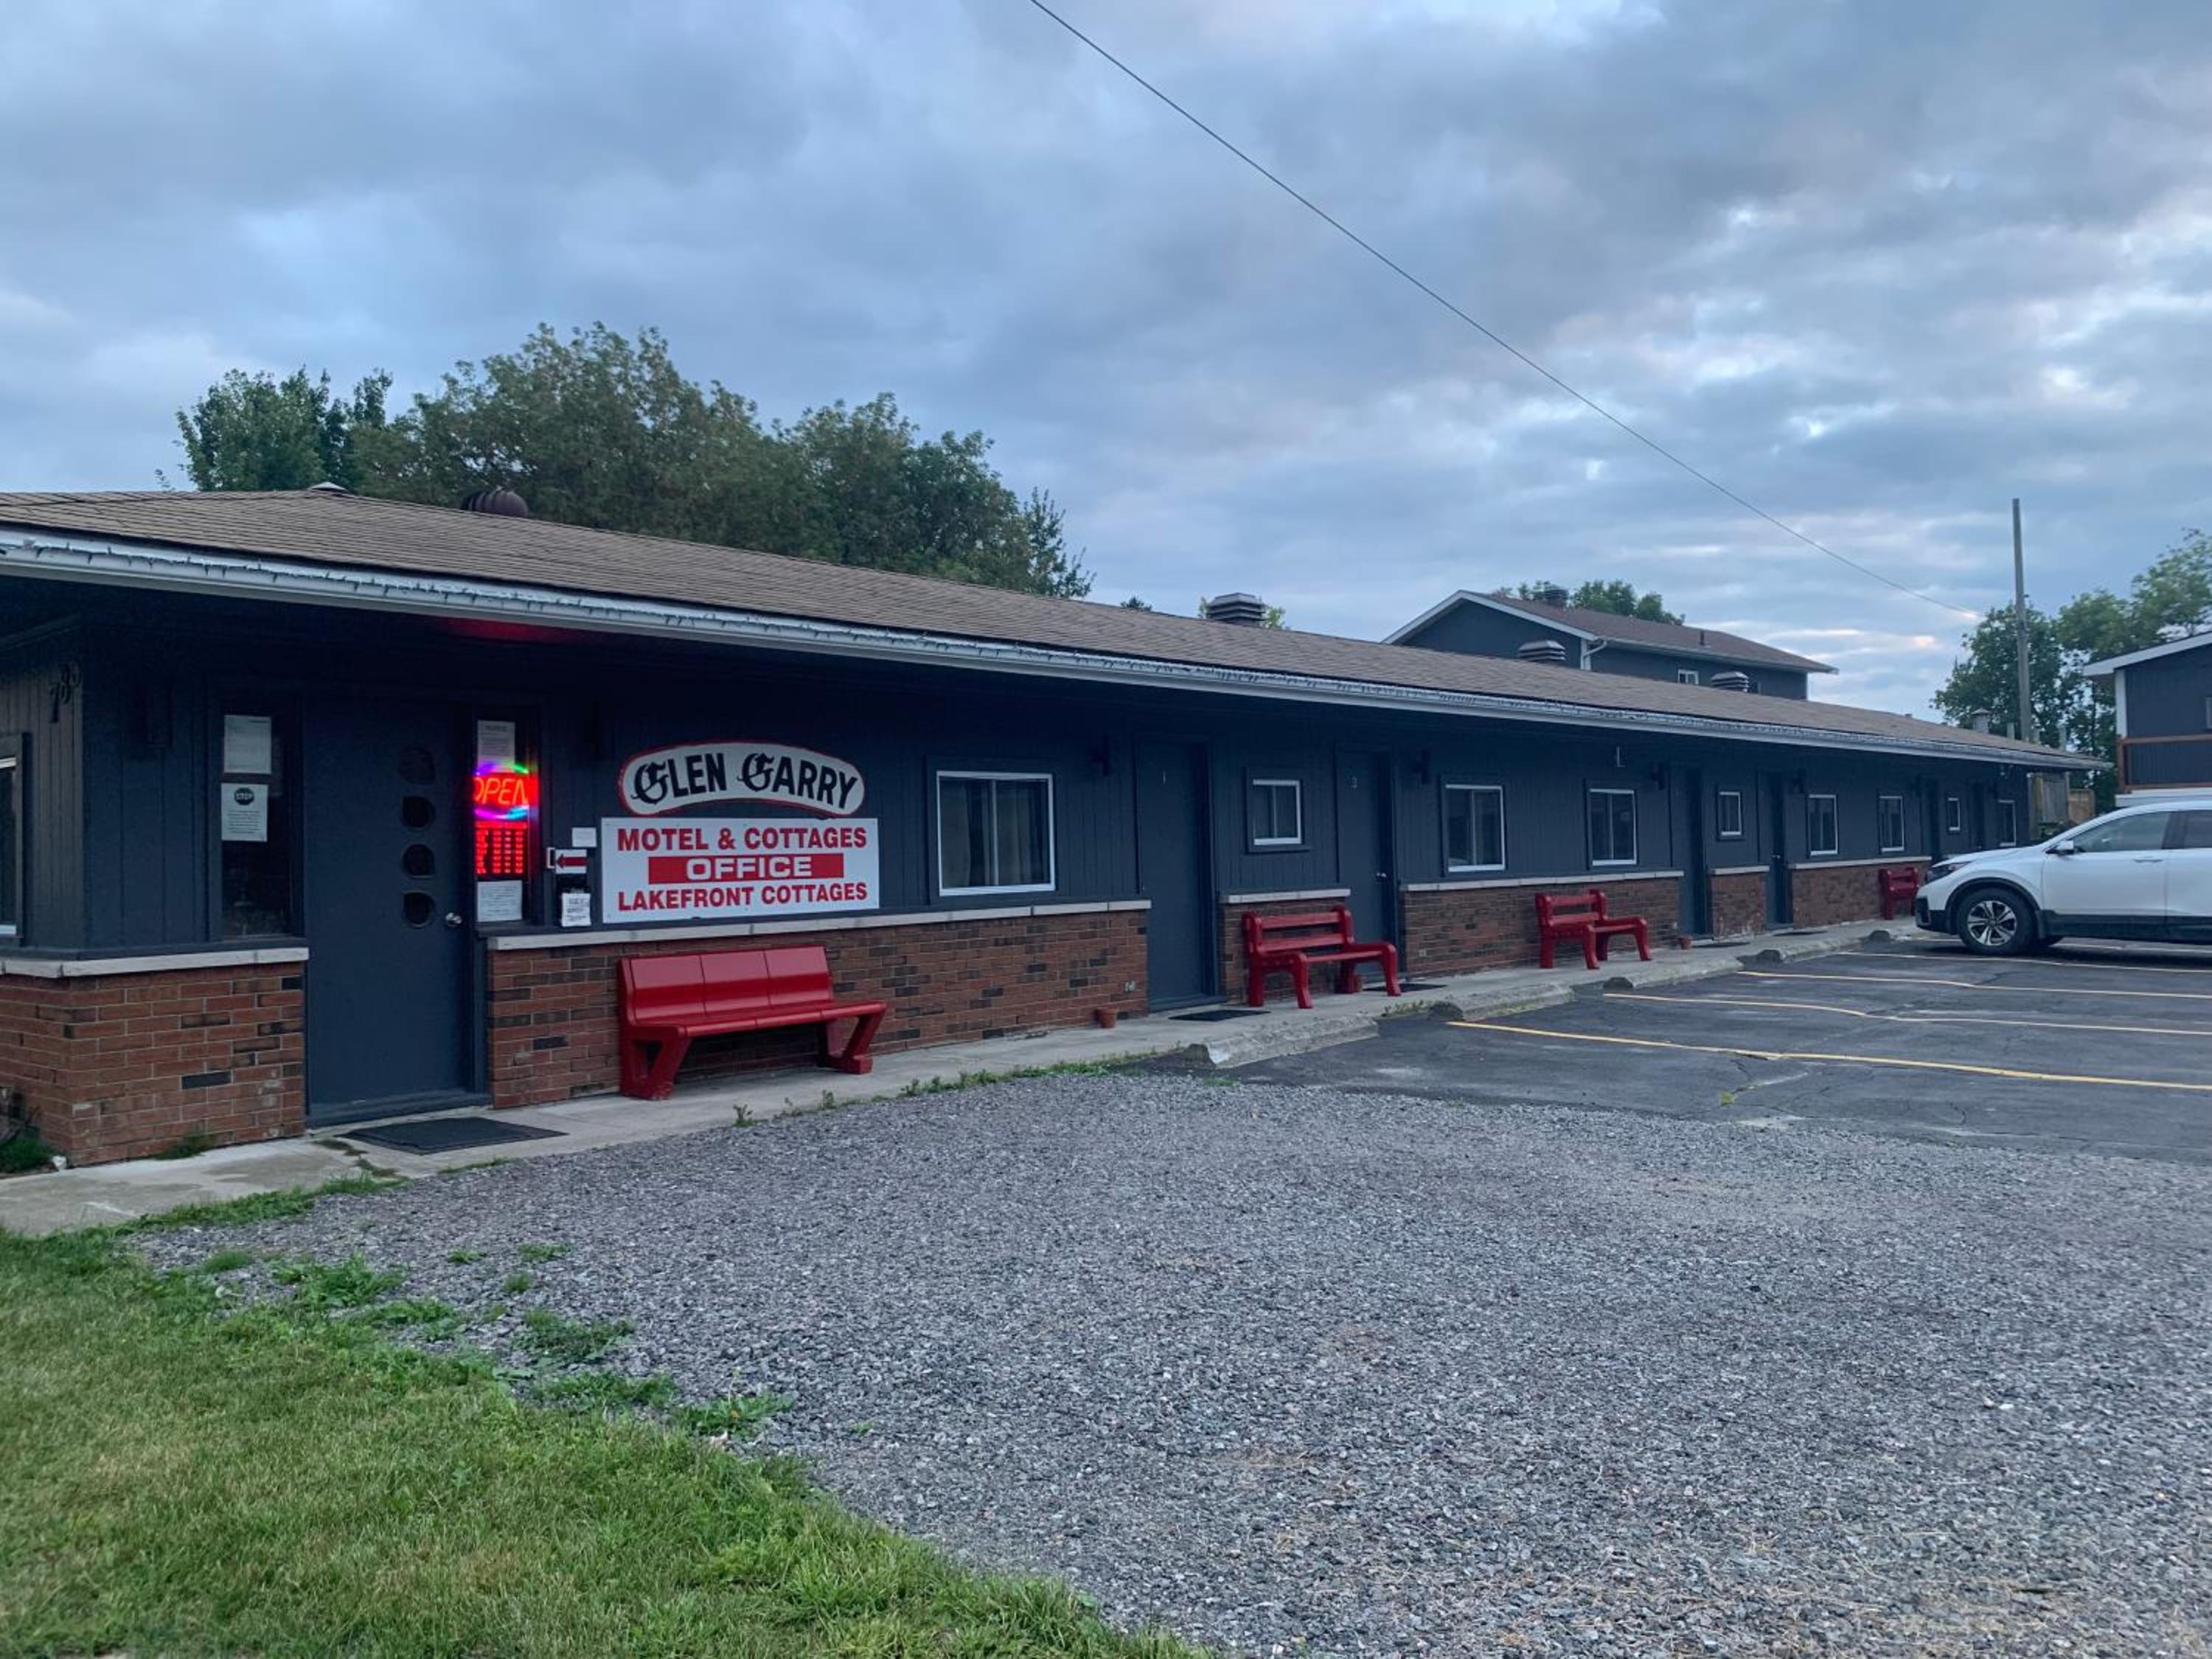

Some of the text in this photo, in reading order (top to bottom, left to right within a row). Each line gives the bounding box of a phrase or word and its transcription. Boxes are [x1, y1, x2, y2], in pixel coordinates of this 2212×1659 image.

[630, 753, 858, 810] GLEN GARRY
[617, 827, 709, 852] MOTEL
[717, 827, 736, 849] &
[744, 827, 867, 849] COTTAGES
[686, 856, 813, 881] OFFICE
[618, 886, 754, 911] LAKEFRONT
[761, 881, 868, 905] COTTAGES
